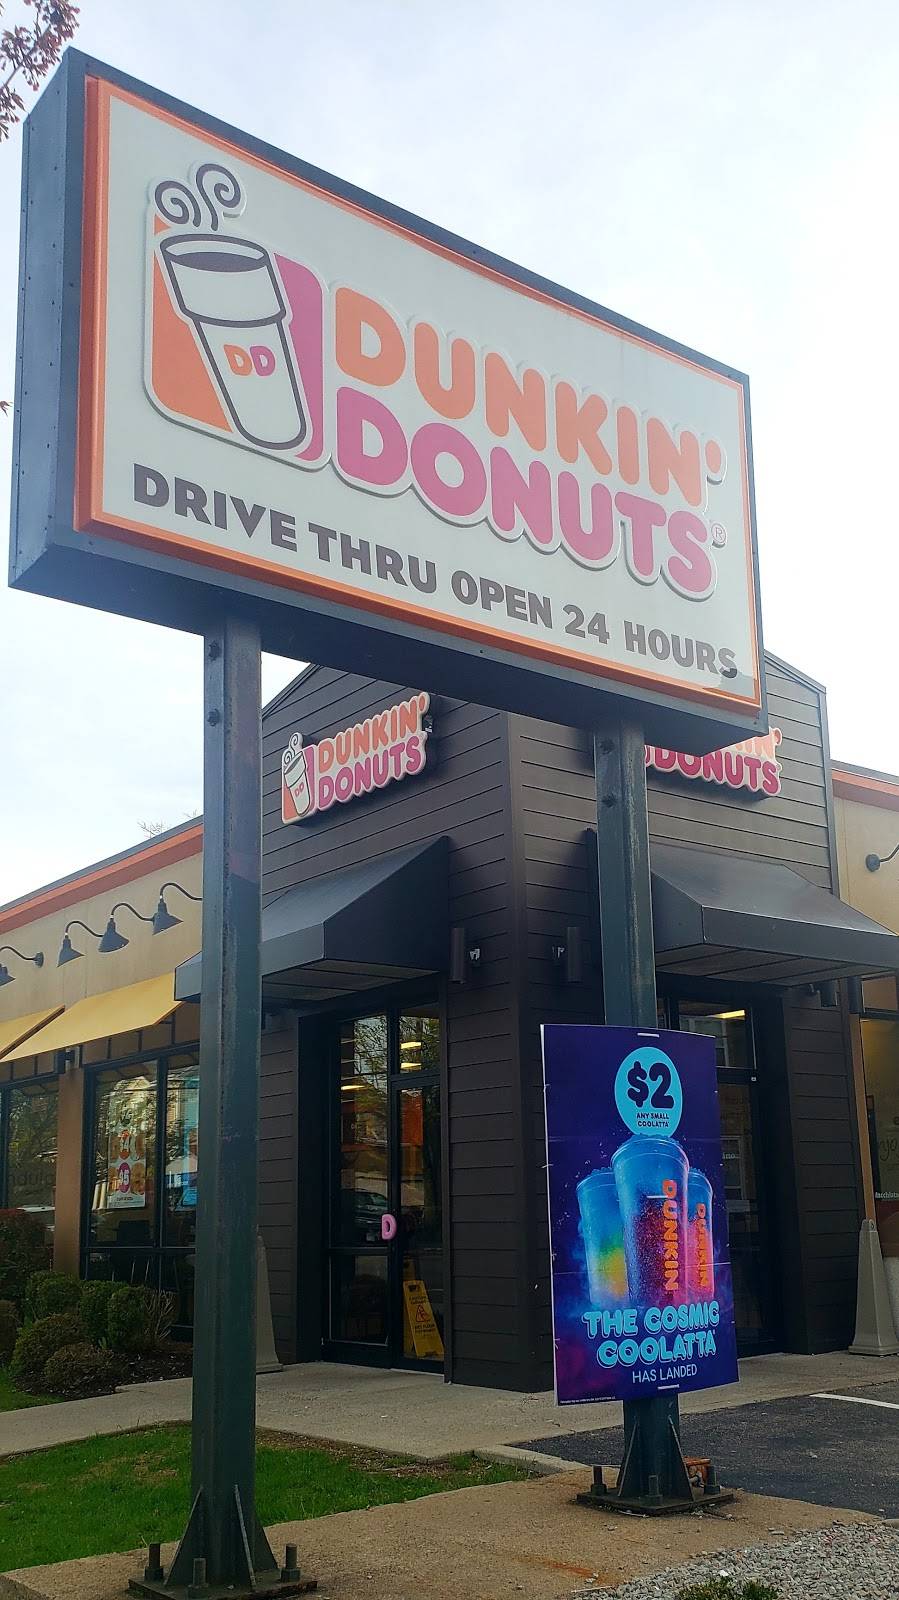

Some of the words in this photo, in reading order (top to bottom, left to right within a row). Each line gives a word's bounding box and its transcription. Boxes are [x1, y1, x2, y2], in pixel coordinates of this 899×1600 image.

[223, 343, 276, 377] DD
[335, 287, 722, 507] DUNKIN'
[336, 386, 712, 593] DONUTS
[133, 463, 297, 552] DRIVE
[308, 522, 437, 593] THRU
[450, 570, 553, 629] OPEN
[563, 604, 610, 645] 24
[623, 619, 738, 679] HOURS
[318, 695, 426, 774] DUNKIN'
[318, 735, 422, 809] DONUTS
[654, 746, 779, 794] DONUTS
[627, 1060, 675, 1109] $2
[637, 1120, 669, 1128] COOLATTA
[650, 1112, 669, 1120] SMALL
[582, 1308, 639, 1338] THE
[643, 1300, 720, 1333] COSMIC
[597, 1331, 717, 1369] COOLATTA
[632, 1368, 657, 1383] HAS
[660, 1364, 698, 1381] LANDED
